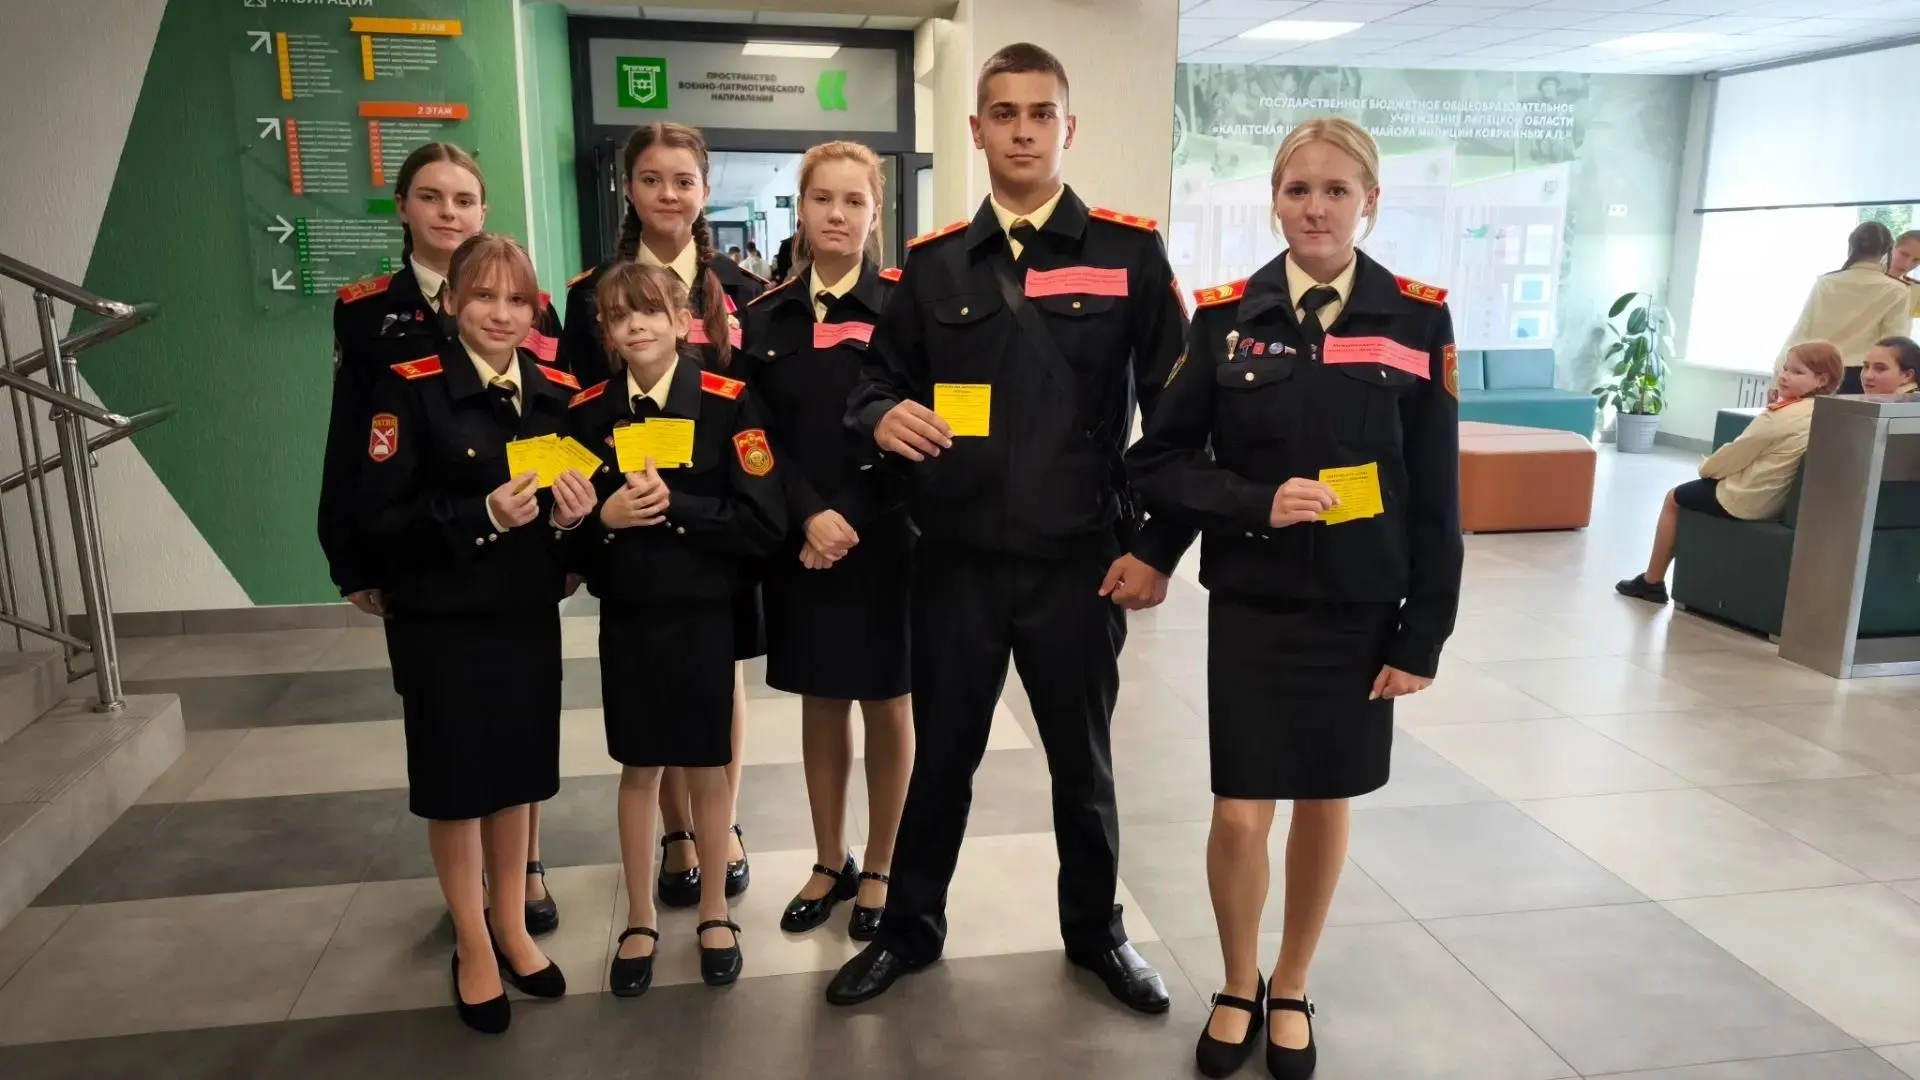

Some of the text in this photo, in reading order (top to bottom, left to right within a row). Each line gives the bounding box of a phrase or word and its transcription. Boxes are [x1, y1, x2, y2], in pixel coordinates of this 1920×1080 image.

[706, 71, 777, 82] ПРОСТРАНСТВО
[678, 81, 805, 93] ВОЕННО-ПАТРИОТИЧЕСКОГО
[711, 92, 774, 102] НАПРАВЛЕНИЯ
[425, 106, 453, 115] ЭТАЖ
[1259, 97, 1575, 113] ГОСУДАРСТВЕННОЕ БЮДЖЕТНОЕ ОБЩЕОБРАЗОВАТЕЛЬНОЕ
[1390, 112, 1574, 126] УЧРЕЖДЕНИЕ ЛИПЕЦКОЙ ОБЛАСТИ
[1370, 124, 1416, 137] МАЙОРА
[1418, 126, 1473, 139] МИЛИЦИИ
[1475, 127, 1544, 139] КОВРИЖНЫХ
